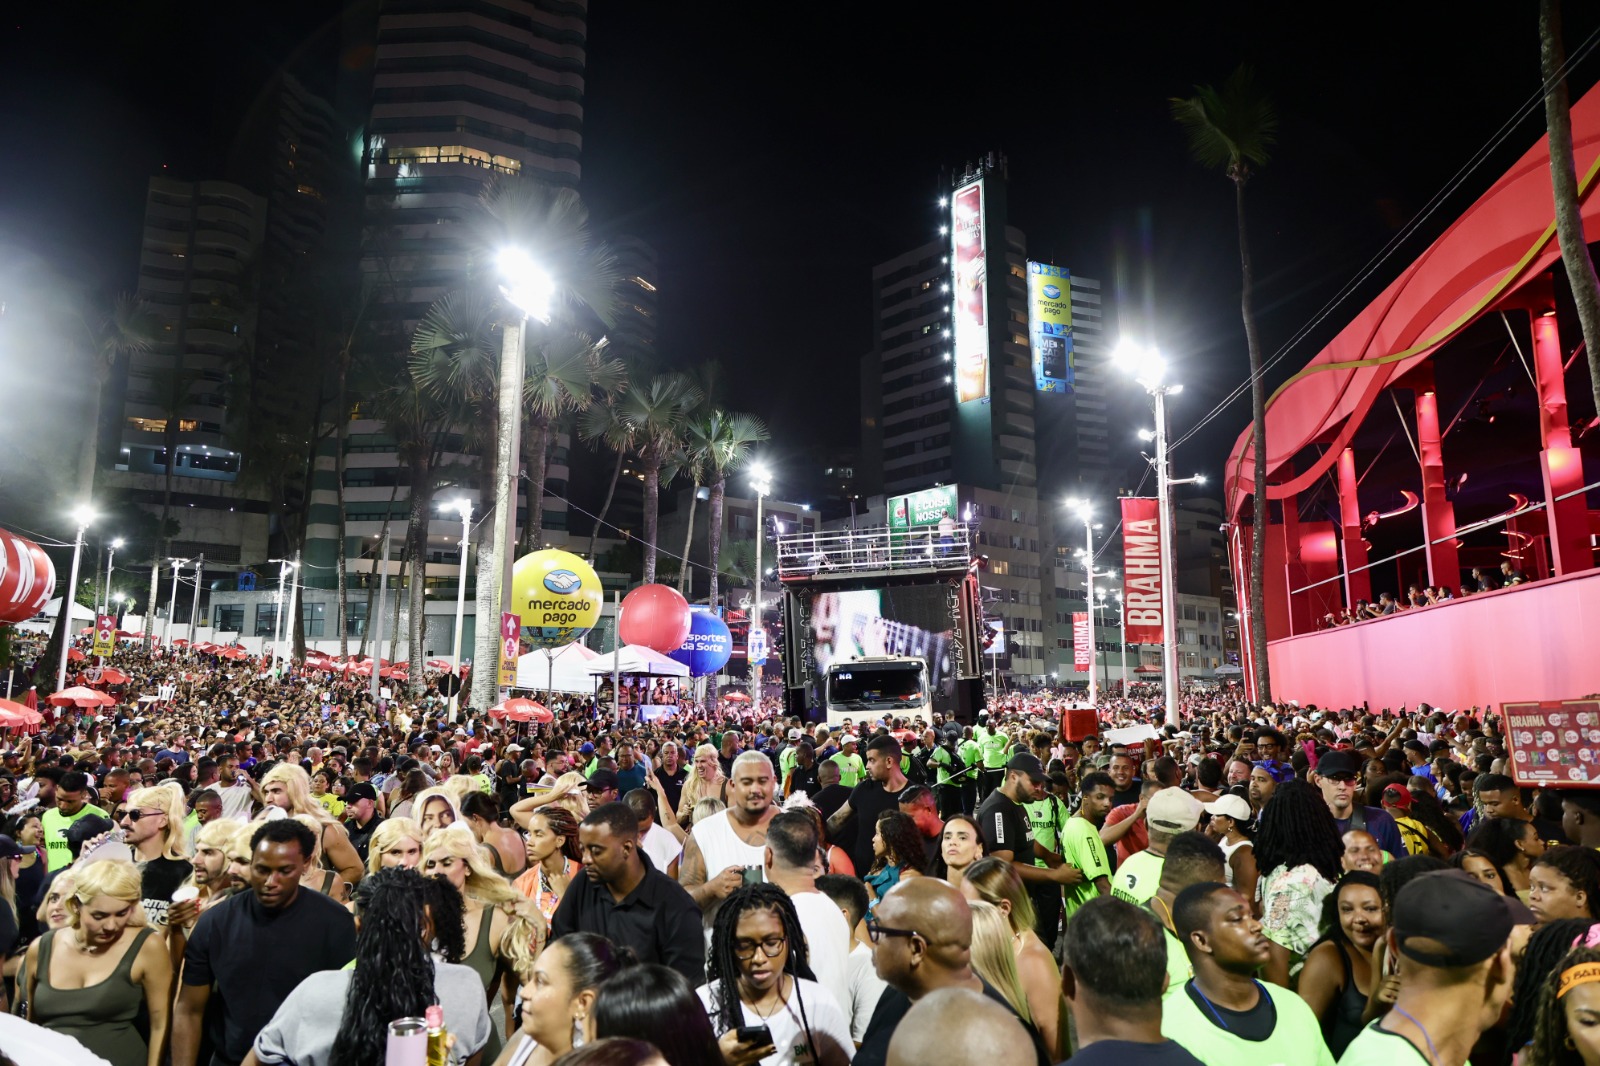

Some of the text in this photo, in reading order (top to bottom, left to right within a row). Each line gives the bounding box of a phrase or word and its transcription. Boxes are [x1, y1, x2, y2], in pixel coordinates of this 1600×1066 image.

[1037, 299, 1067, 310] mercado
[1044, 307, 1061, 315] pago
[922, 495, 951, 510] COISA
[1125, 518, 1162, 626] BRAHMA
[528, 599, 591, 611] mercado
[542, 611, 577, 625] pago
[687, 633, 727, 643] sportes
[1074, 620, 1090, 665] BRAHMA
[681, 642, 724, 652] da Sorte
[1510, 715, 1546, 728] BRAHMA
